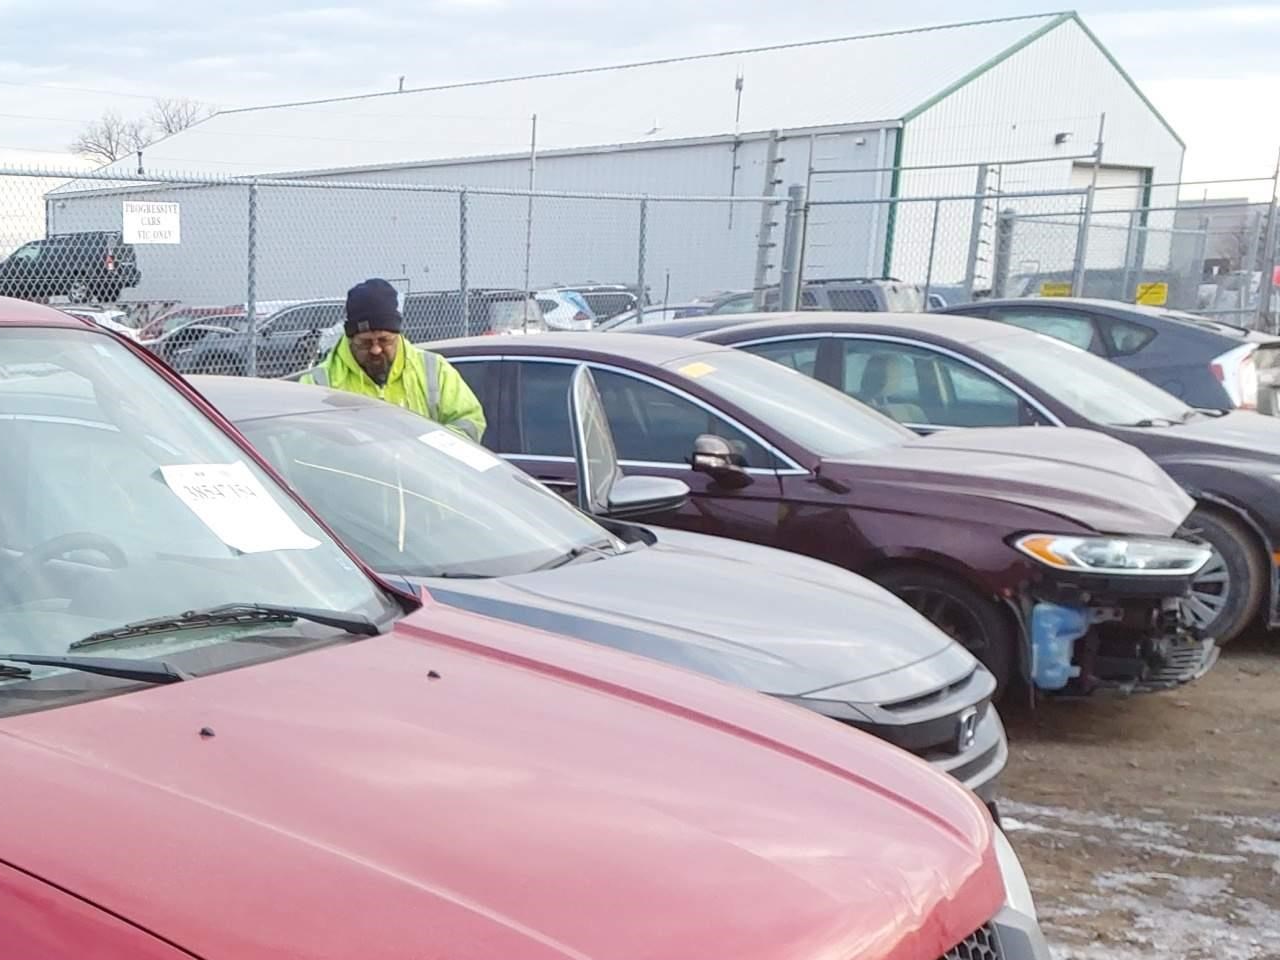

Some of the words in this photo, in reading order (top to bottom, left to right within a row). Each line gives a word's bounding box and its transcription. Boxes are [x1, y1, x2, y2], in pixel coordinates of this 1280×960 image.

[125, 203, 178, 214] PROGRESSIVE
[141, 216, 161, 226] CARS
[153, 230, 172, 240] ONLY
